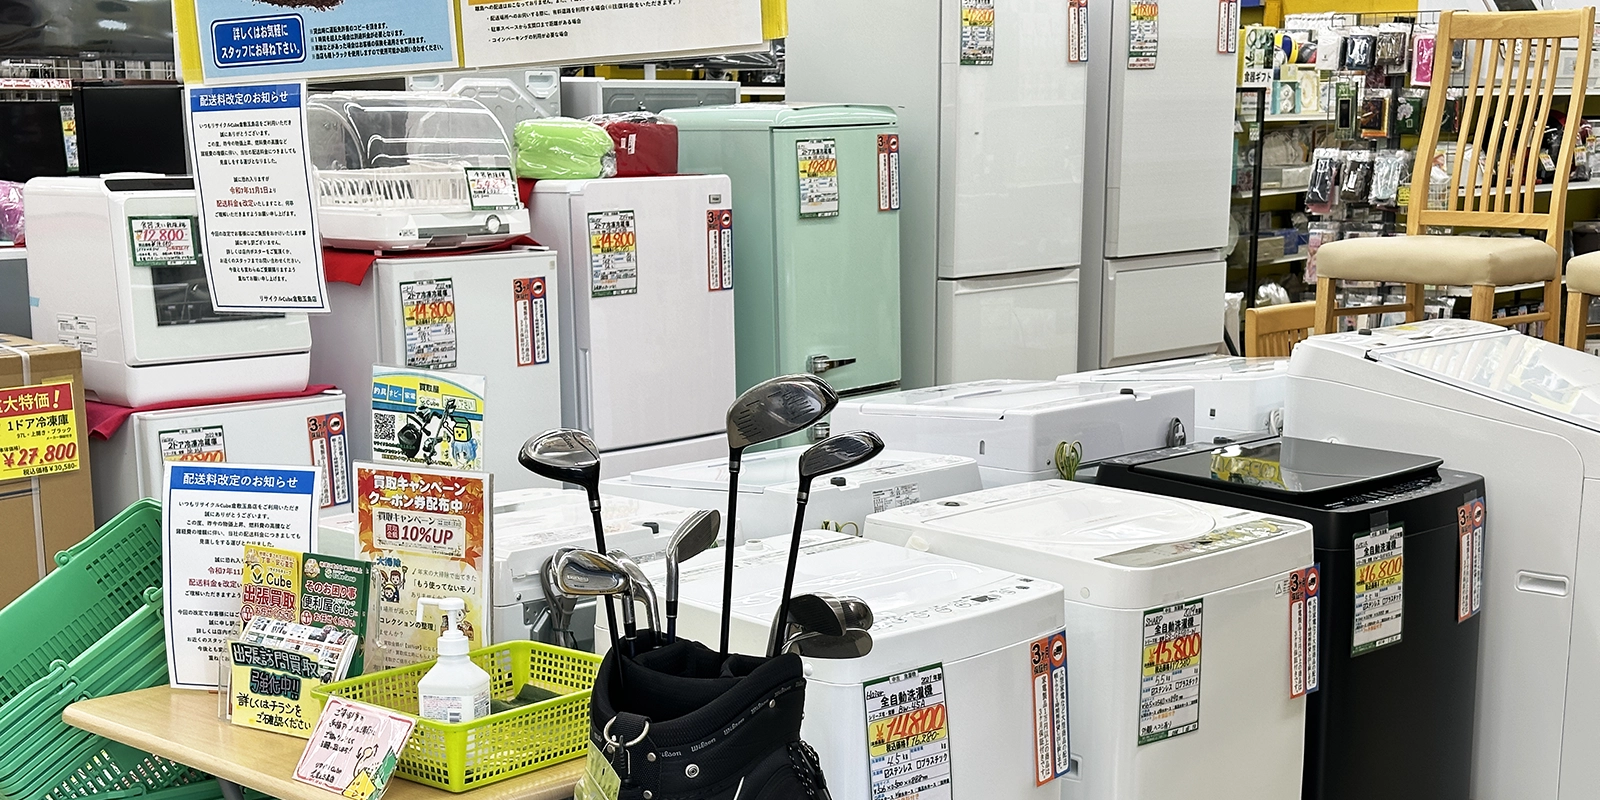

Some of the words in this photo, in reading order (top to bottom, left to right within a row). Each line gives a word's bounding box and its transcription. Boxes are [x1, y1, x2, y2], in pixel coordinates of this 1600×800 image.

[231, 24, 289, 40] 詳しくはお気軽に
[221, 42, 300, 60] スタッフにお尋ね下さい。
[1244, 71, 1272, 83] 食器ギフト
[199, 91, 289, 106] 配送料改定のお知らせ
[374, 386, 387, 396] 釣具
[0, 390, 60, 413] 大特価!
[8, 413, 69, 432] 1ドア冷凍庫
[168, 438, 217, 450] 2ドア冷凍冷蔵庫
[2, 442, 76, 468] ¥27,800
[183, 473, 298, 488] 配送料改定のお知らせ
[373, 474, 466, 496] 買取キャンペーン
[178, 501, 299, 511] いつもリサイクルCube倉敷玉島店をご利用いただき
[204, 511, 270, 520] 誠にありがとうございます。
[377, 511, 435, 525] 買取キャンペーン
[186, 520, 291, 530] この度、昨今の物価上昇、燃料費の高騰など
[401, 525, 454, 545] 10%UP
[1364, 540, 1397, 557] 全自動洗濯機
[1360, 556, 1402, 582] ¥16,800
[266, 573, 292, 588] Cube
[413, 580, 476, 594] 「もう使ってないモノ」
[243, 584, 297, 611] 出張買取
[1155, 617, 1194, 636] 全自動洗濯機
[231, 643, 320, 679] 出張訪問買取
[250, 669, 301, 700] 強化中!!
[236, 692, 302, 718] 詳しくはチラシを
[881, 684, 933, 709] 全自動洗濯機
[256, 712, 311, 730] ご確認ください
[723, 717, 745, 735] Wilson
[691, 737, 716, 752] Wilson
[661, 750, 682, 758] ilson
[889, 763, 913, 778] ステンレス
[921, 753, 948, 769] プラスチック
